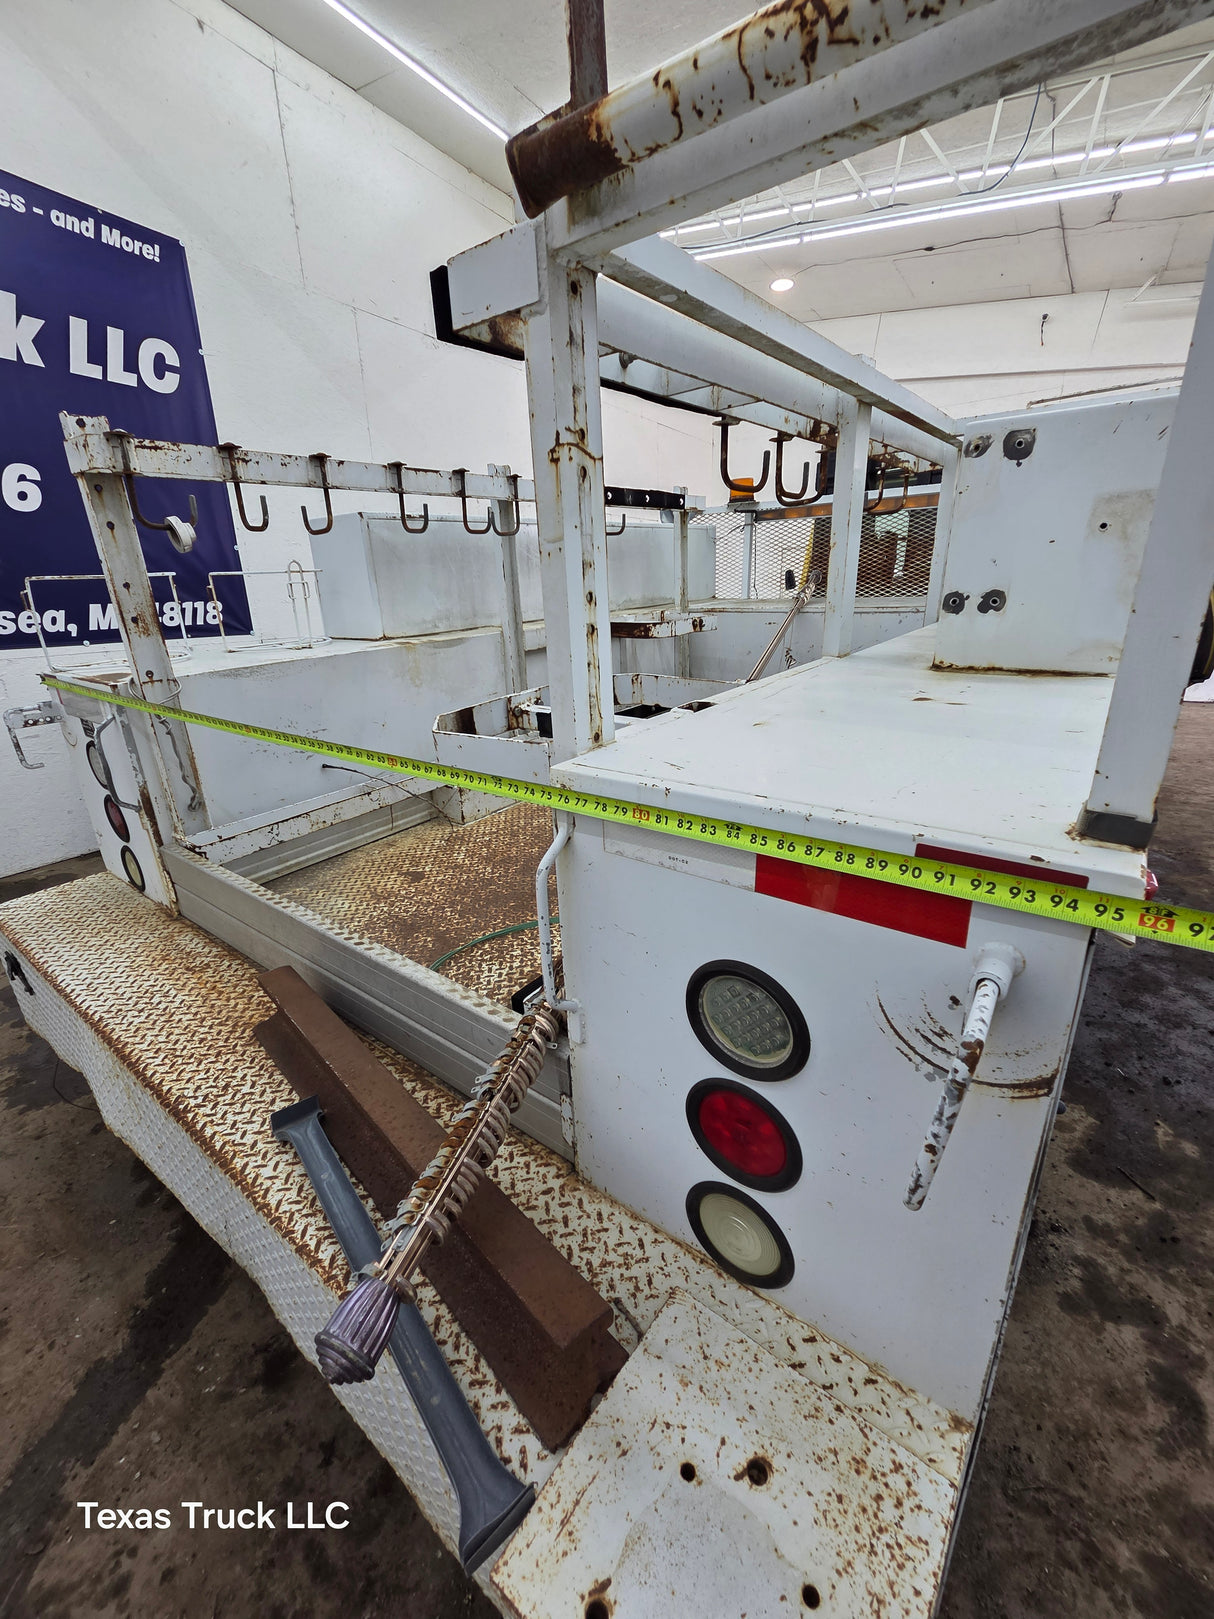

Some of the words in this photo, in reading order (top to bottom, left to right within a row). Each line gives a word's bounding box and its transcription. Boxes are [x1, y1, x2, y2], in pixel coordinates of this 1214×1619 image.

[50, 209, 95, 239] and
[101, 224, 160, 262] More!
[0, 289, 46, 368] k
[69, 315, 180, 394] LLC
[1, 463, 42, 512] 6
[400, 761, 409, 769] 65
[412, 763, 421, 772] 66
[424, 766, 433, 774] 67
[436, 769, 447, 777] 68
[450, 771, 460, 780] 69
[463, 773, 474, 783] 70
[477, 776, 487, 786] 71
[493, 781, 503, 789] 72
[507, 783, 519, 793] 73
[523, 786, 536, 797] 74
[540, 790, 553, 800] 75
[558, 793, 570, 804] 76
[575, 797, 588, 808] 77
[594, 801, 608, 812] 78
[613, 805, 628, 816] 79
[633, 809, 648, 820] 80
[655, 813, 669, 826] 81
[677, 818, 693, 831] 82
[700, 823, 716, 836] 83
[726, 830, 740, 840] 84
[749, 833, 768, 847] 85
[776, 839, 796, 853] 86
[804, 844, 825, 858] 87
[834, 850, 856, 865] 88
[865, 857, 888, 872] 89
[898, 863, 922, 879] 90
[933, 870, 956, 886] 91
[970, 878, 997, 895] 92
[1008, 886, 1036, 903] 93
[1050, 894, 1079, 913] 94
[1094, 903, 1125, 922] 95
[1143, 915, 1169, 931] 96
